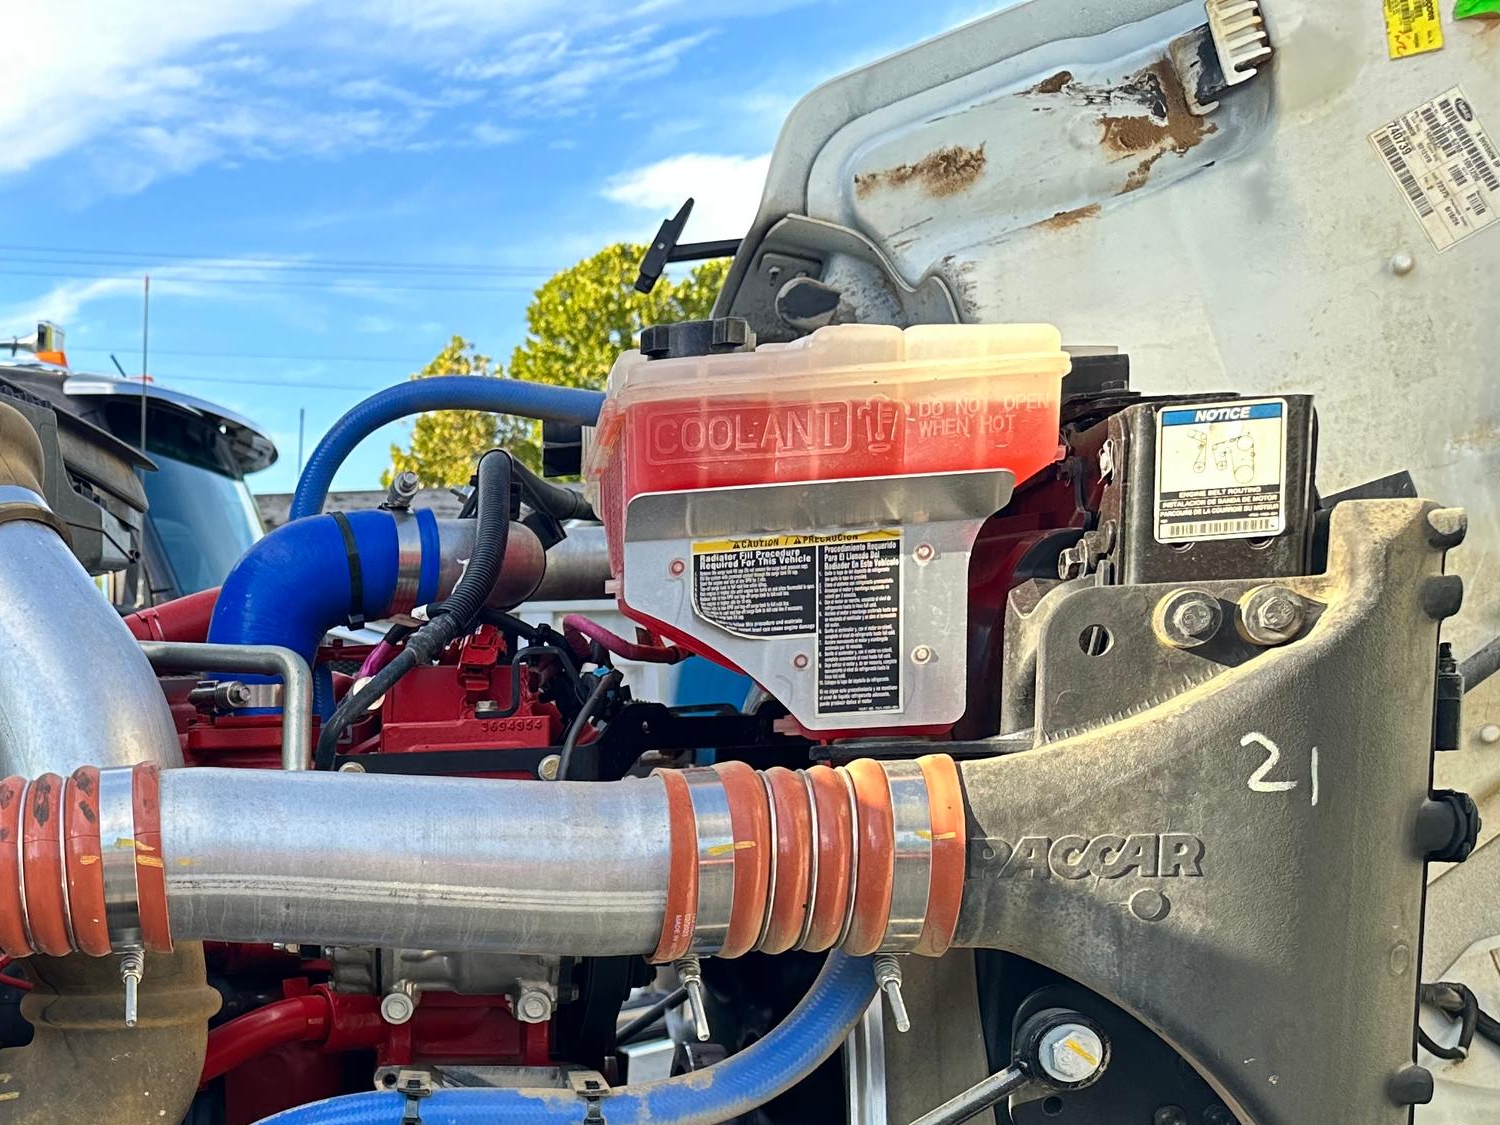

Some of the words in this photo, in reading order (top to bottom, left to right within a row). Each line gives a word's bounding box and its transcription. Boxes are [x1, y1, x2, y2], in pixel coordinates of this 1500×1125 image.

[1386, 121, 1412, 156] 740739
[918, 400, 943, 418] DO
[955, 398, 989, 414] NOT
[1003, 393, 1049, 410] OPEN
[1195, 406, 1251, 422] NOTICE
[654, 407, 840, 454] COOLANT
[920, 418, 970, 437] WHEN
[980, 415, 1014, 433] HOT
[1178, 490, 1206, 498] ENGINE
[1207, 488, 1226, 496] BELT
[1227, 486, 1261, 494] ROUTING
[1217, 496, 1240, 504] BANDA
[1252, 493, 1277, 502] MOTOR
[741, 539, 779, 549] CAUTION
[699, 552, 737, 563] Radiator
[739, 551, 753, 560] Fill
[755, 547, 800, 558] Procedure
[699, 560, 738, 570] Required
[741, 558, 755, 566] For
[758, 556, 776, 565] This
[779, 554, 811, 564] Vehicle
[824, 553, 837, 561] Para
[824, 560, 850, 570] Radiador
[1240, 732, 1319, 806] 21
[966, 833, 1206, 881] PACCAR
